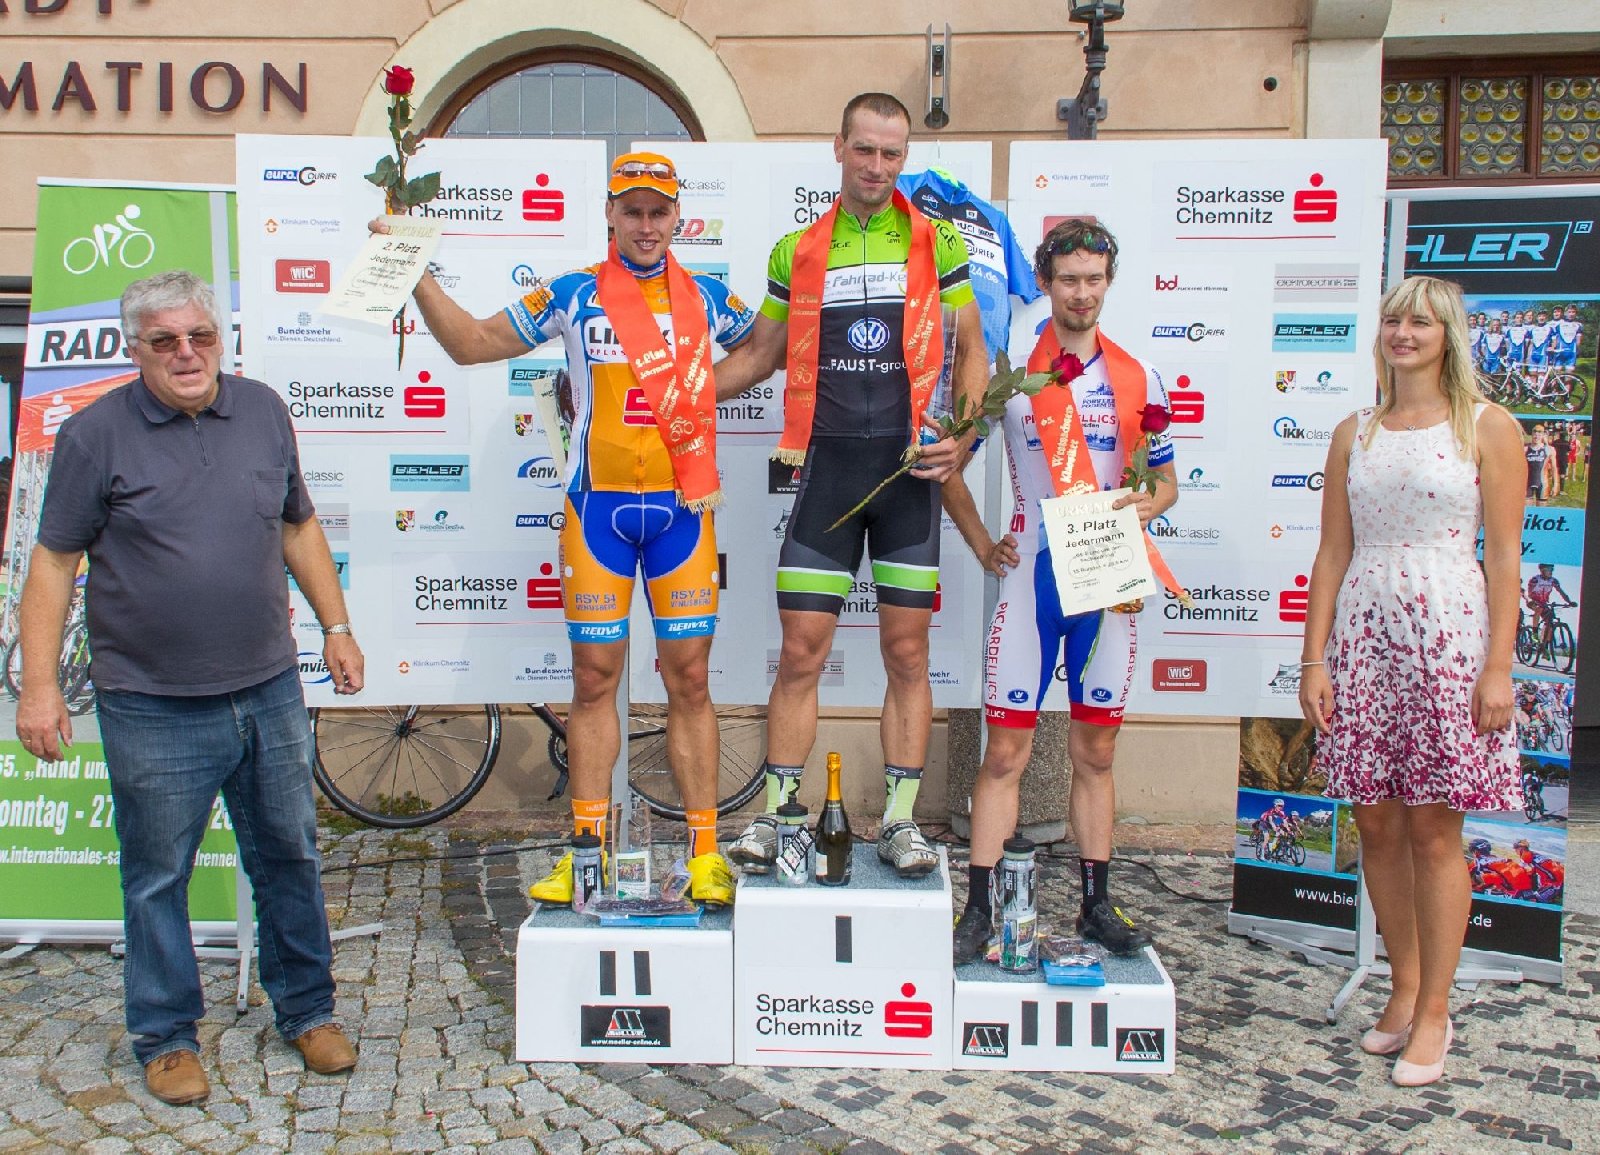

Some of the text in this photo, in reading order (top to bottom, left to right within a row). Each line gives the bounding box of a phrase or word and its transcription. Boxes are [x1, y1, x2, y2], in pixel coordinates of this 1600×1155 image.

[436, 185, 513, 201] arkasse
[794, 187, 841, 207] Spar
[1177, 186, 1285, 207] Sparkasse
[1176, 207, 1273, 224] Chemnitz
[832, 271, 907, 288] Fahrrad-Ke
[278, 326, 331, 335] Bundeswehr
[1154, 326, 1185, 336] euro.
[1278, 326, 1346, 335] BIEHLER
[40, 327, 133, 362] RAD
[289, 381, 394, 400] Sparkasse
[289, 402, 385, 419] Chemnitz
[716, 403, 765, 420] mnitz
[304, 470, 345, 481] classic
[395, 466, 461, 475] BIEHLER
[1274, 477, 1305, 485] euro.
[518, 516, 546, 526] euro.
[1067, 519, 1117, 534] 3. Platz
[1065, 532, 1125, 548] Jedermann
[1156, 523, 1220, 540] iKK classic
[415, 575, 518, 594] Sparkasse
[415, 594, 508, 611] Chemnitz
[575, 594, 616, 604] RSV 54
[671, 588, 712, 600] RSV 54
[1164, 585, 1270, 603] Sarkasse
[1163, 604, 1258, 622] Chemnitz
[1119, 614, 1137, 703] PICARDELLIC
[525, 667, 573, 675] Bundesweh
[756, 993, 874, 1015] Sparkasse
[756, 1016, 863, 1037] Chemnitz
